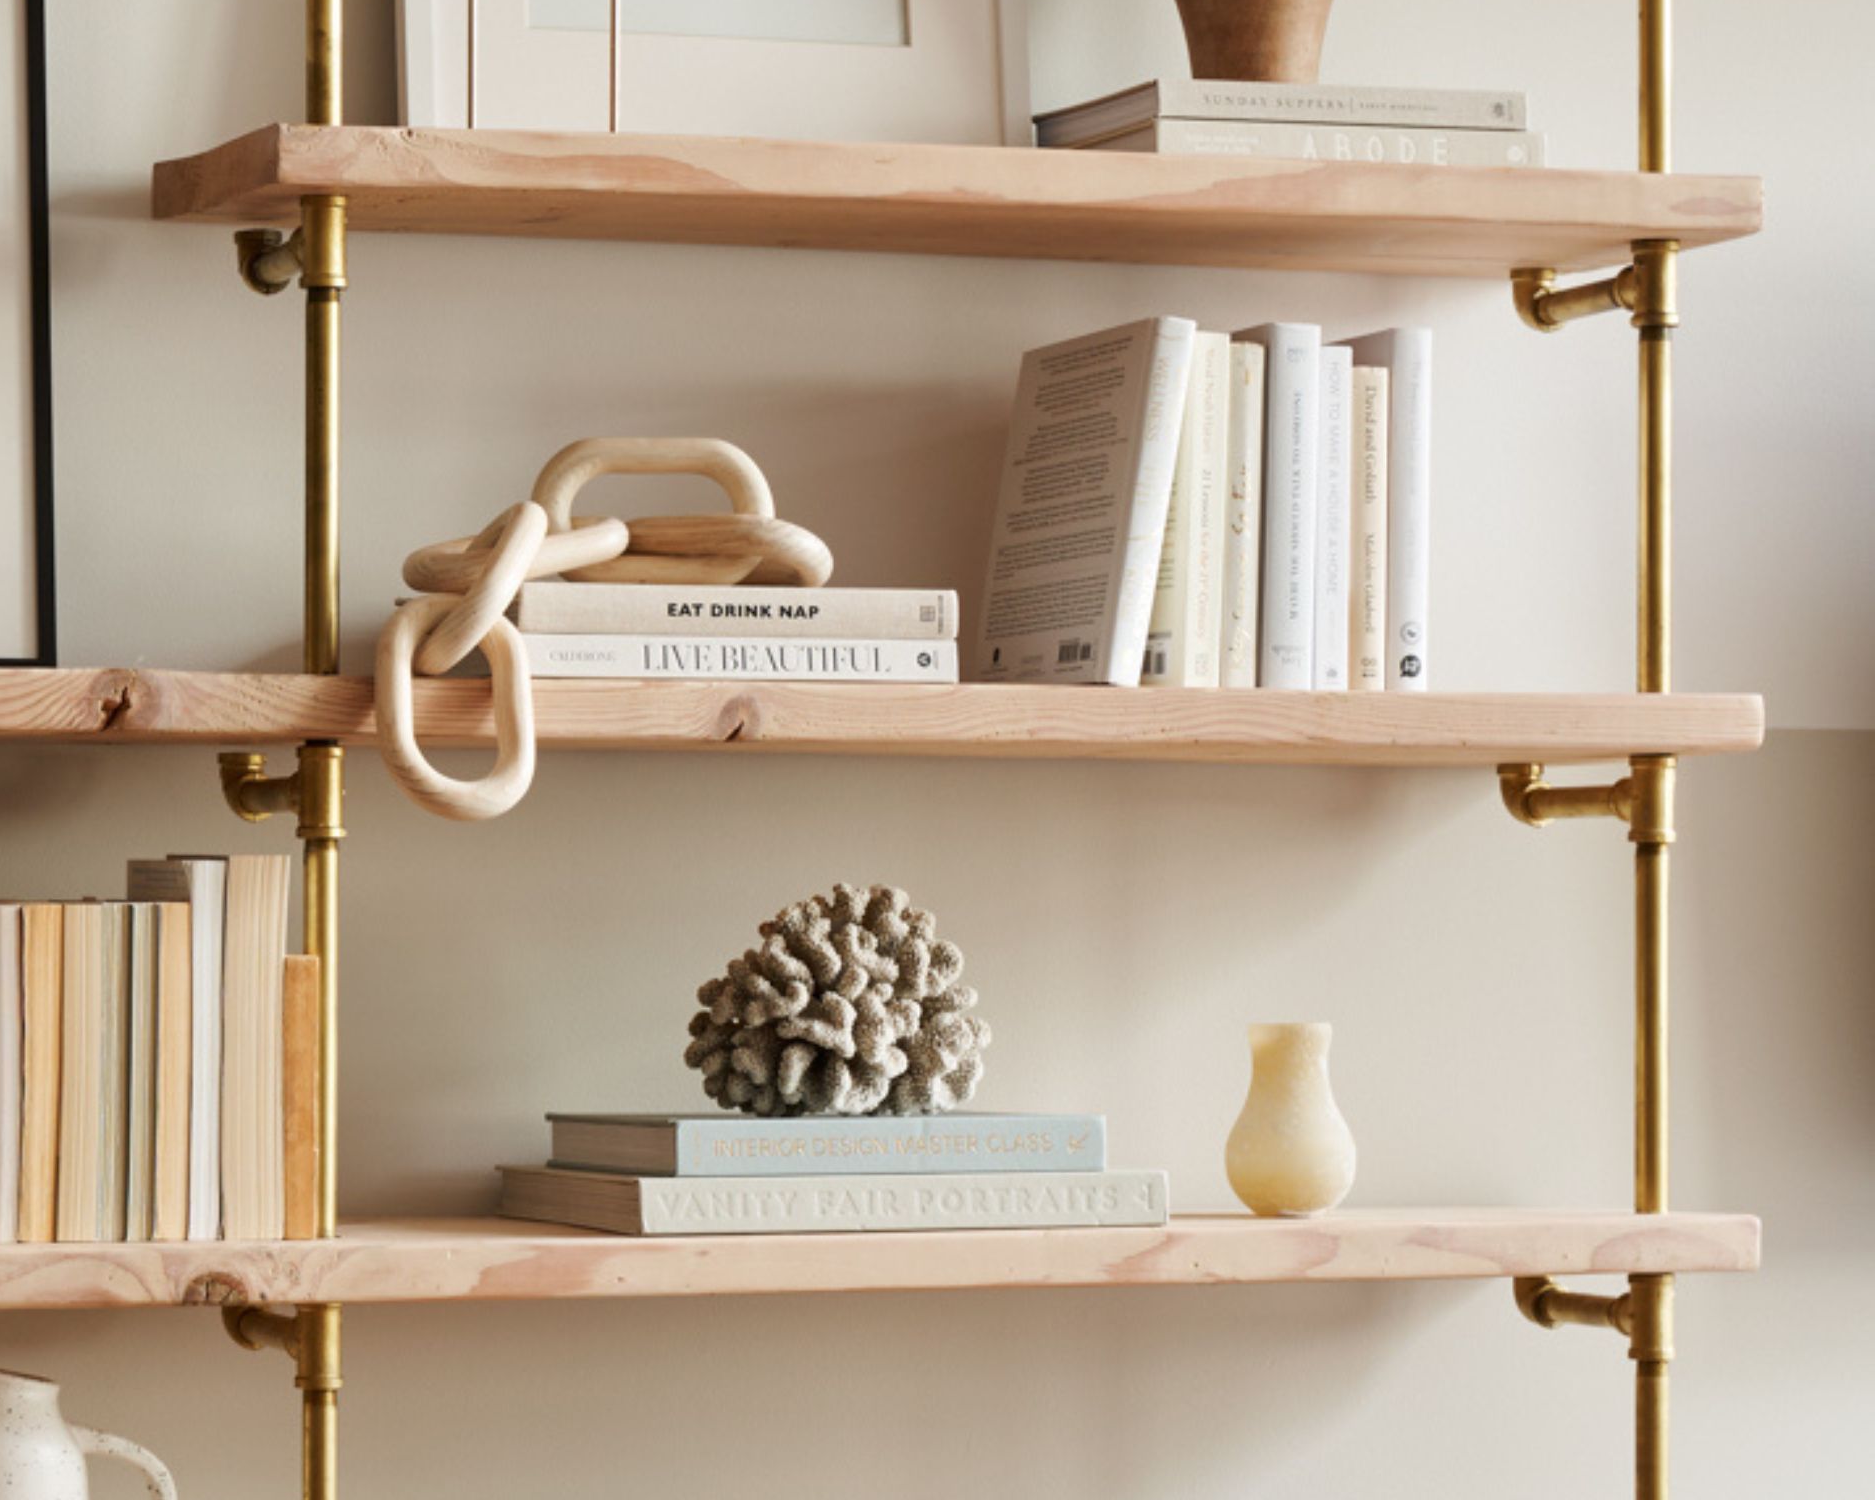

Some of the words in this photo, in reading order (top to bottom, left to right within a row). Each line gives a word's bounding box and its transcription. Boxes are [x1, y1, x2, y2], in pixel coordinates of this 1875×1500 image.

[1303, 132, 1448, 166] ABODE
[1327, 361, 1342, 397] HOW
[1327, 402, 1340, 419] TO
[1364, 385, 1377, 425] David
[1327, 426, 1340, 463] MAKE
[1363, 428, 1376, 452] and
[1362, 454, 1377, 505] Goliath
[1326, 490, 1340, 535] HOUSE
[1325, 553, 1338, 596] HOME
[667, 602, 703, 617] EAT
[710, 603, 773, 619] DRINK
[779, 604, 821, 619] NAP
[642, 643, 713, 672] LIVE
[721, 643, 891, 674] BEAUTIFUL
[713, 1137, 807, 1157] INTERIOR
[811, 1136, 889, 1156] DESIGN
[895, 1134, 979, 1155] MASTER
[985, 1132, 1055, 1153] CLASS
[656, 1188, 798, 1219] VANITY
[814, 1187, 900, 1217] FAIR
[914, 1184, 1119, 1215] PORTRAITS
